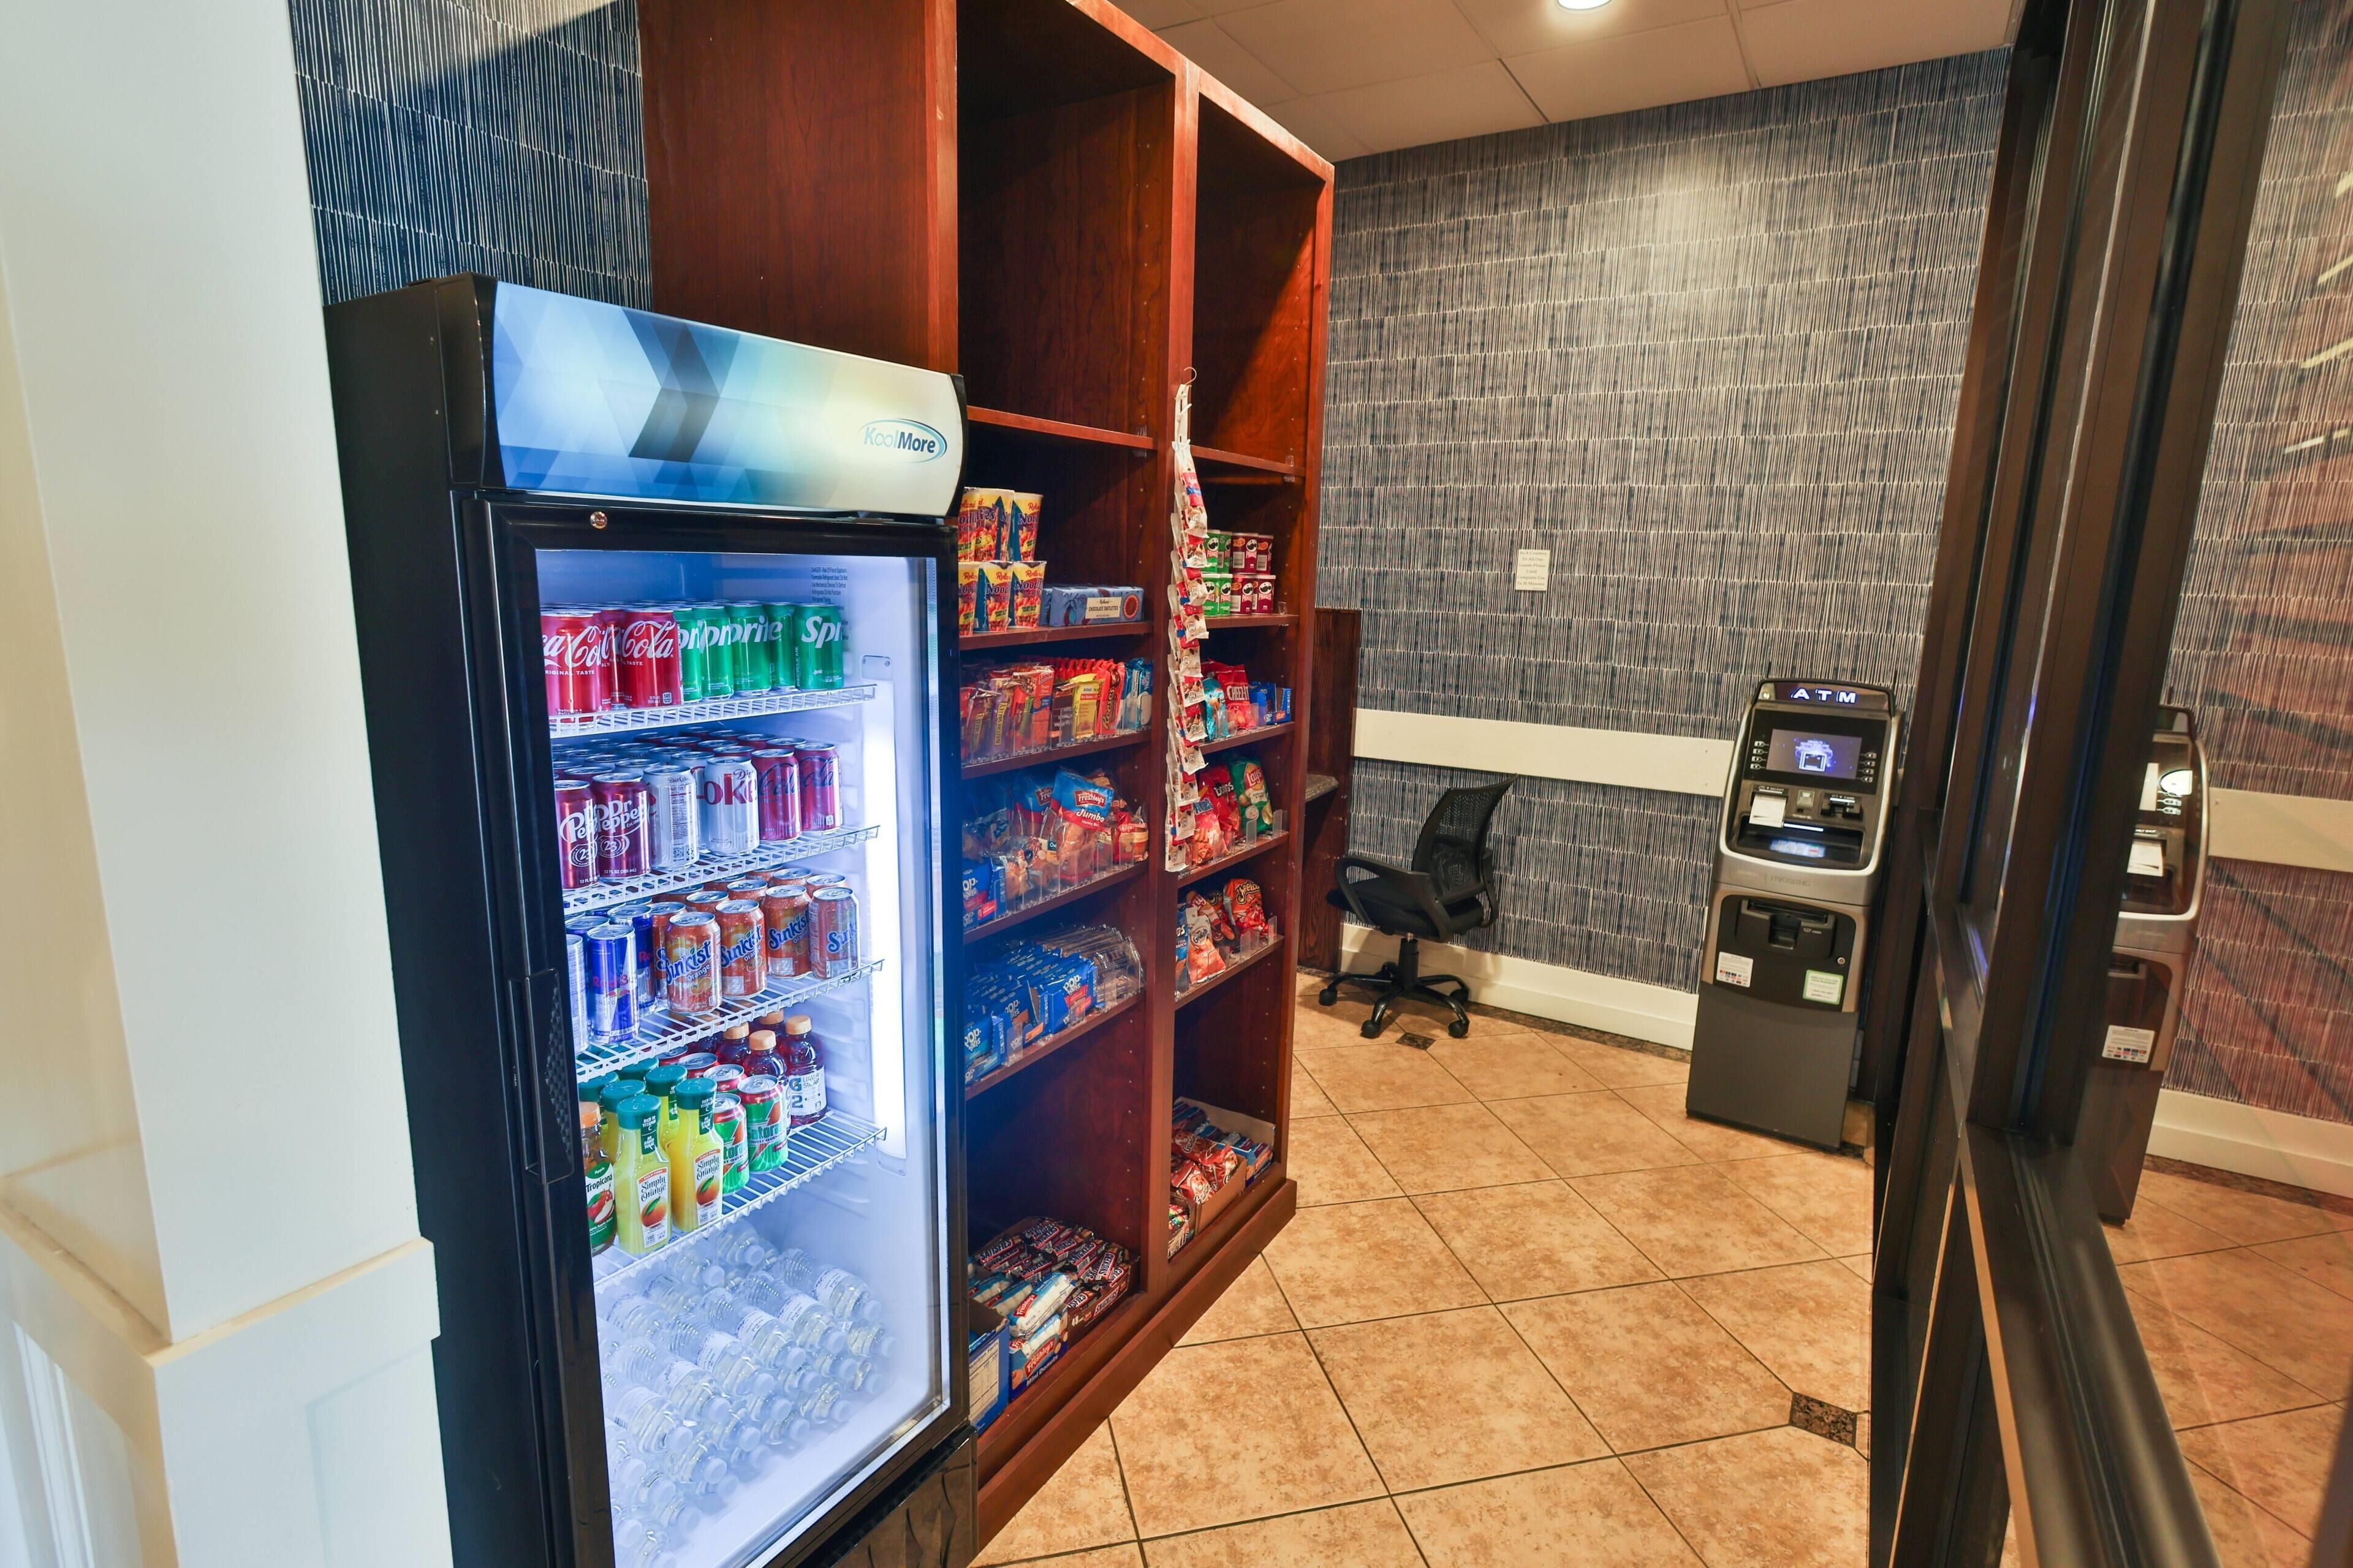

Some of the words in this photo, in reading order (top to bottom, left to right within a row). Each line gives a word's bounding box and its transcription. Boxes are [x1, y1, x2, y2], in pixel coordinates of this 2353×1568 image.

[863, 426, 936, 453] KoolMore
[1226, 685, 1249, 701] CHEEZ-IT
[1790, 687, 1857, 704] ATM
[1103, 687, 1115, 730] Reese's
[1246, 769, 1262, 787] Lay's
[608, 800, 632, 816] Dr
[1077, 793, 1105, 805] Freshley's
[1076, 808, 1105, 823] Jumbo
[604, 840, 618, 852] 23
[721, 924, 762, 968] Sunkist
[666, 940, 711, 985] Sunkist
[686, 963, 711, 981] Orange
[792, 1095, 803, 1108] 2
[696, 1163, 720, 1181] Orange
[697, 1154, 720, 1172] Simply
[585, 1173, 613, 1194] Tropicana
[642, 1175, 666, 1194] Simply
[643, 1171, 653, 1180] PULP
[641, 1183, 666, 1202] Orange
[980, 1238, 1012, 1260] SATISFIES
[1017, 1294, 1037, 1316] Freshley's
[1027, 1341, 1055, 1372] Freshley's
[1026, 1373, 1039, 1387] Mini
[1039, 1354, 1059, 1375] Donuts
